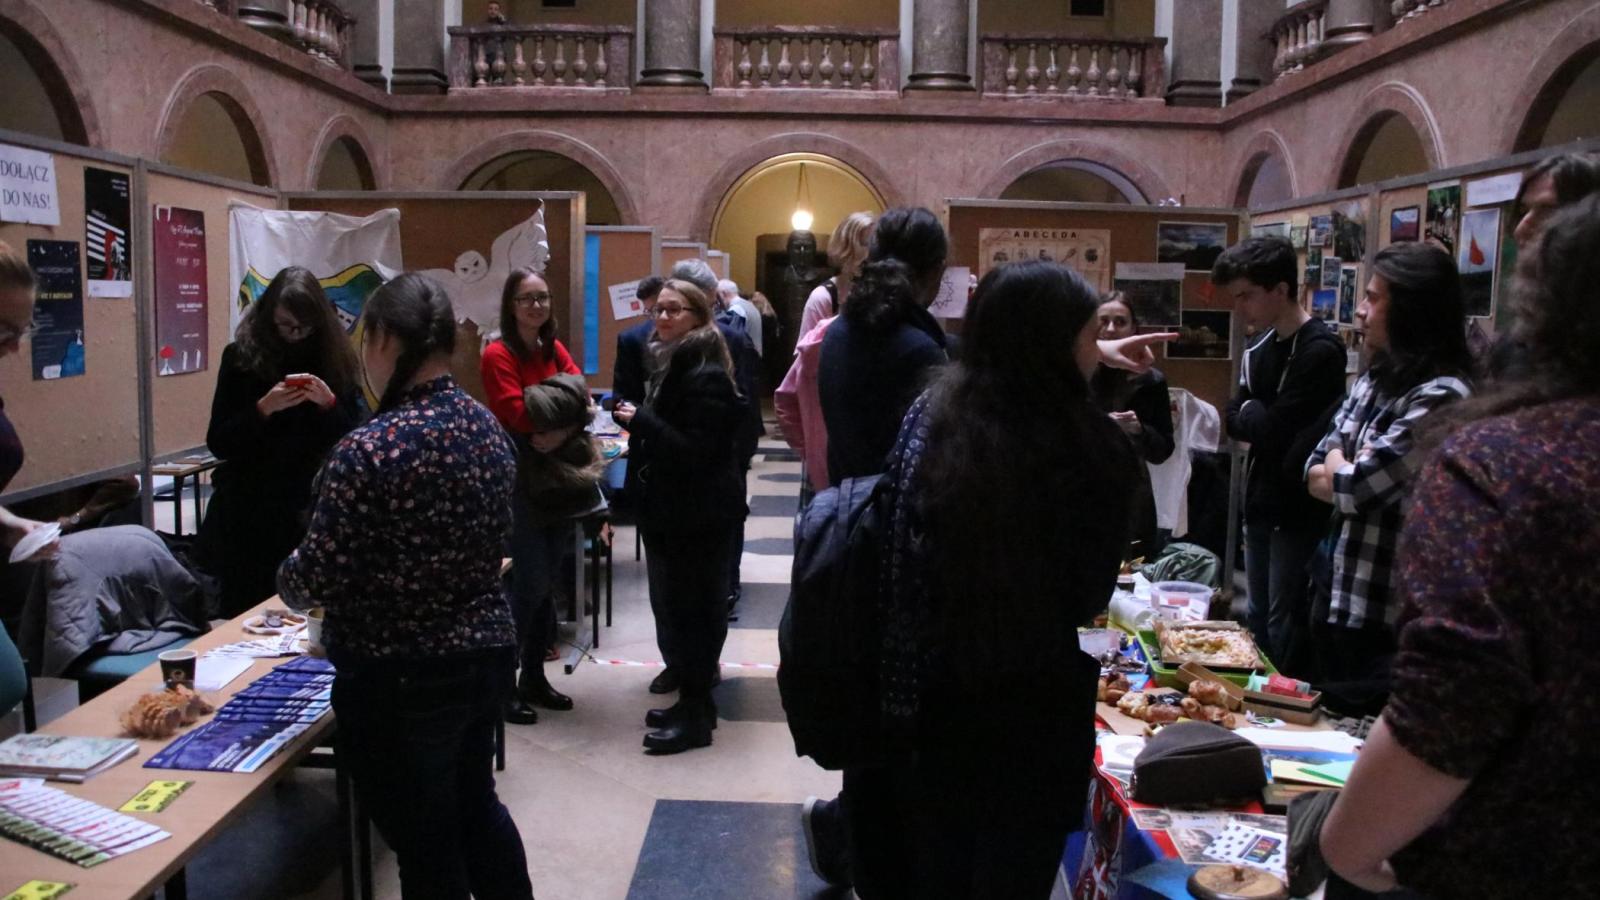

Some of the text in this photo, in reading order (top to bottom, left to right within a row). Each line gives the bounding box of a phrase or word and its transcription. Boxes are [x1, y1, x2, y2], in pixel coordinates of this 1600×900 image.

[2, 188, 51, 210] DO NAS!
[1014, 230, 1077, 239] ABECEDA
